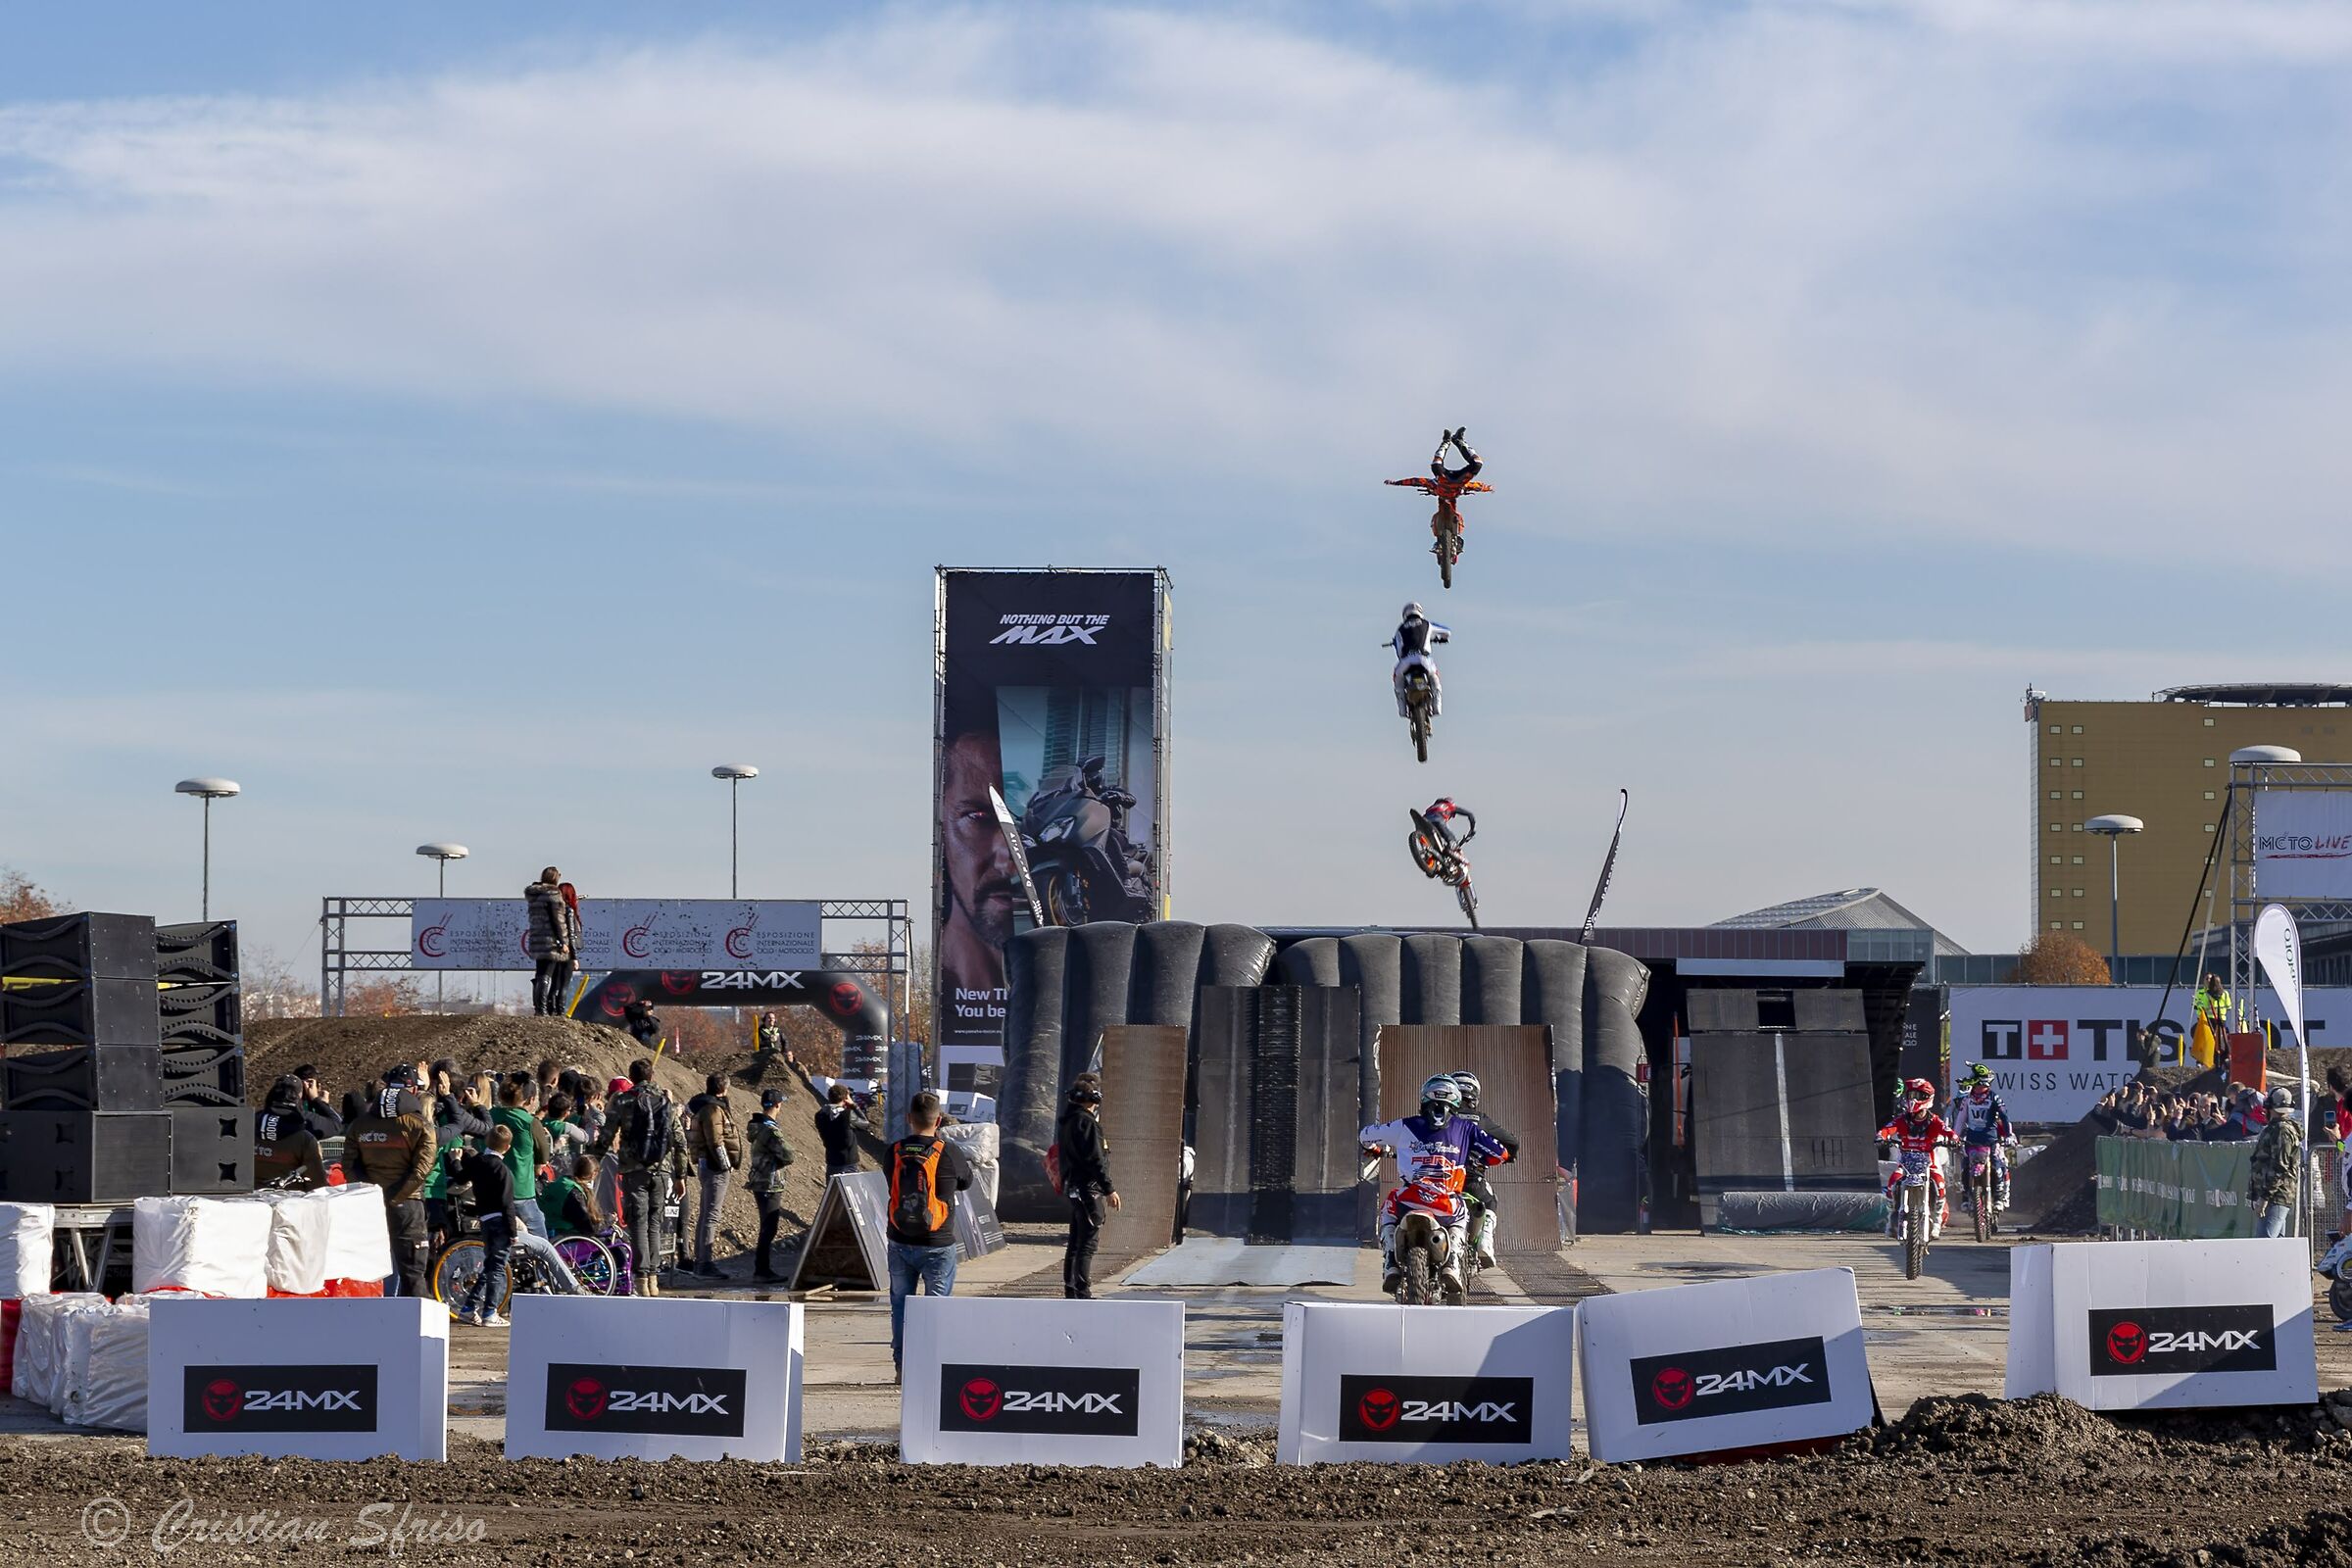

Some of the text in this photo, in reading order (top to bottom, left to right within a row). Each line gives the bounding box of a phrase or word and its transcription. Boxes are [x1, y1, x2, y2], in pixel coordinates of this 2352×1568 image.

[1000, 613, 1110, 625] NOTHING BUT THE
[989, 625, 1104, 645] MAX
[701, 971, 805, 989] 24MX
[956, 987, 990, 1001] New
[955, 1004, 984, 1017] You
[1995, 1072, 2057, 1090] WISS
[2148, 1329, 2262, 1352] 24MX
[1695, 1363, 1814, 1396] 24MX
[244, 1390, 362, 1410] 24MX
[608, 1391, 729, 1415] 24MX
[1003, 1391, 1123, 1414] 24MX
[1400, 1400, 1517, 1422] 24MX
